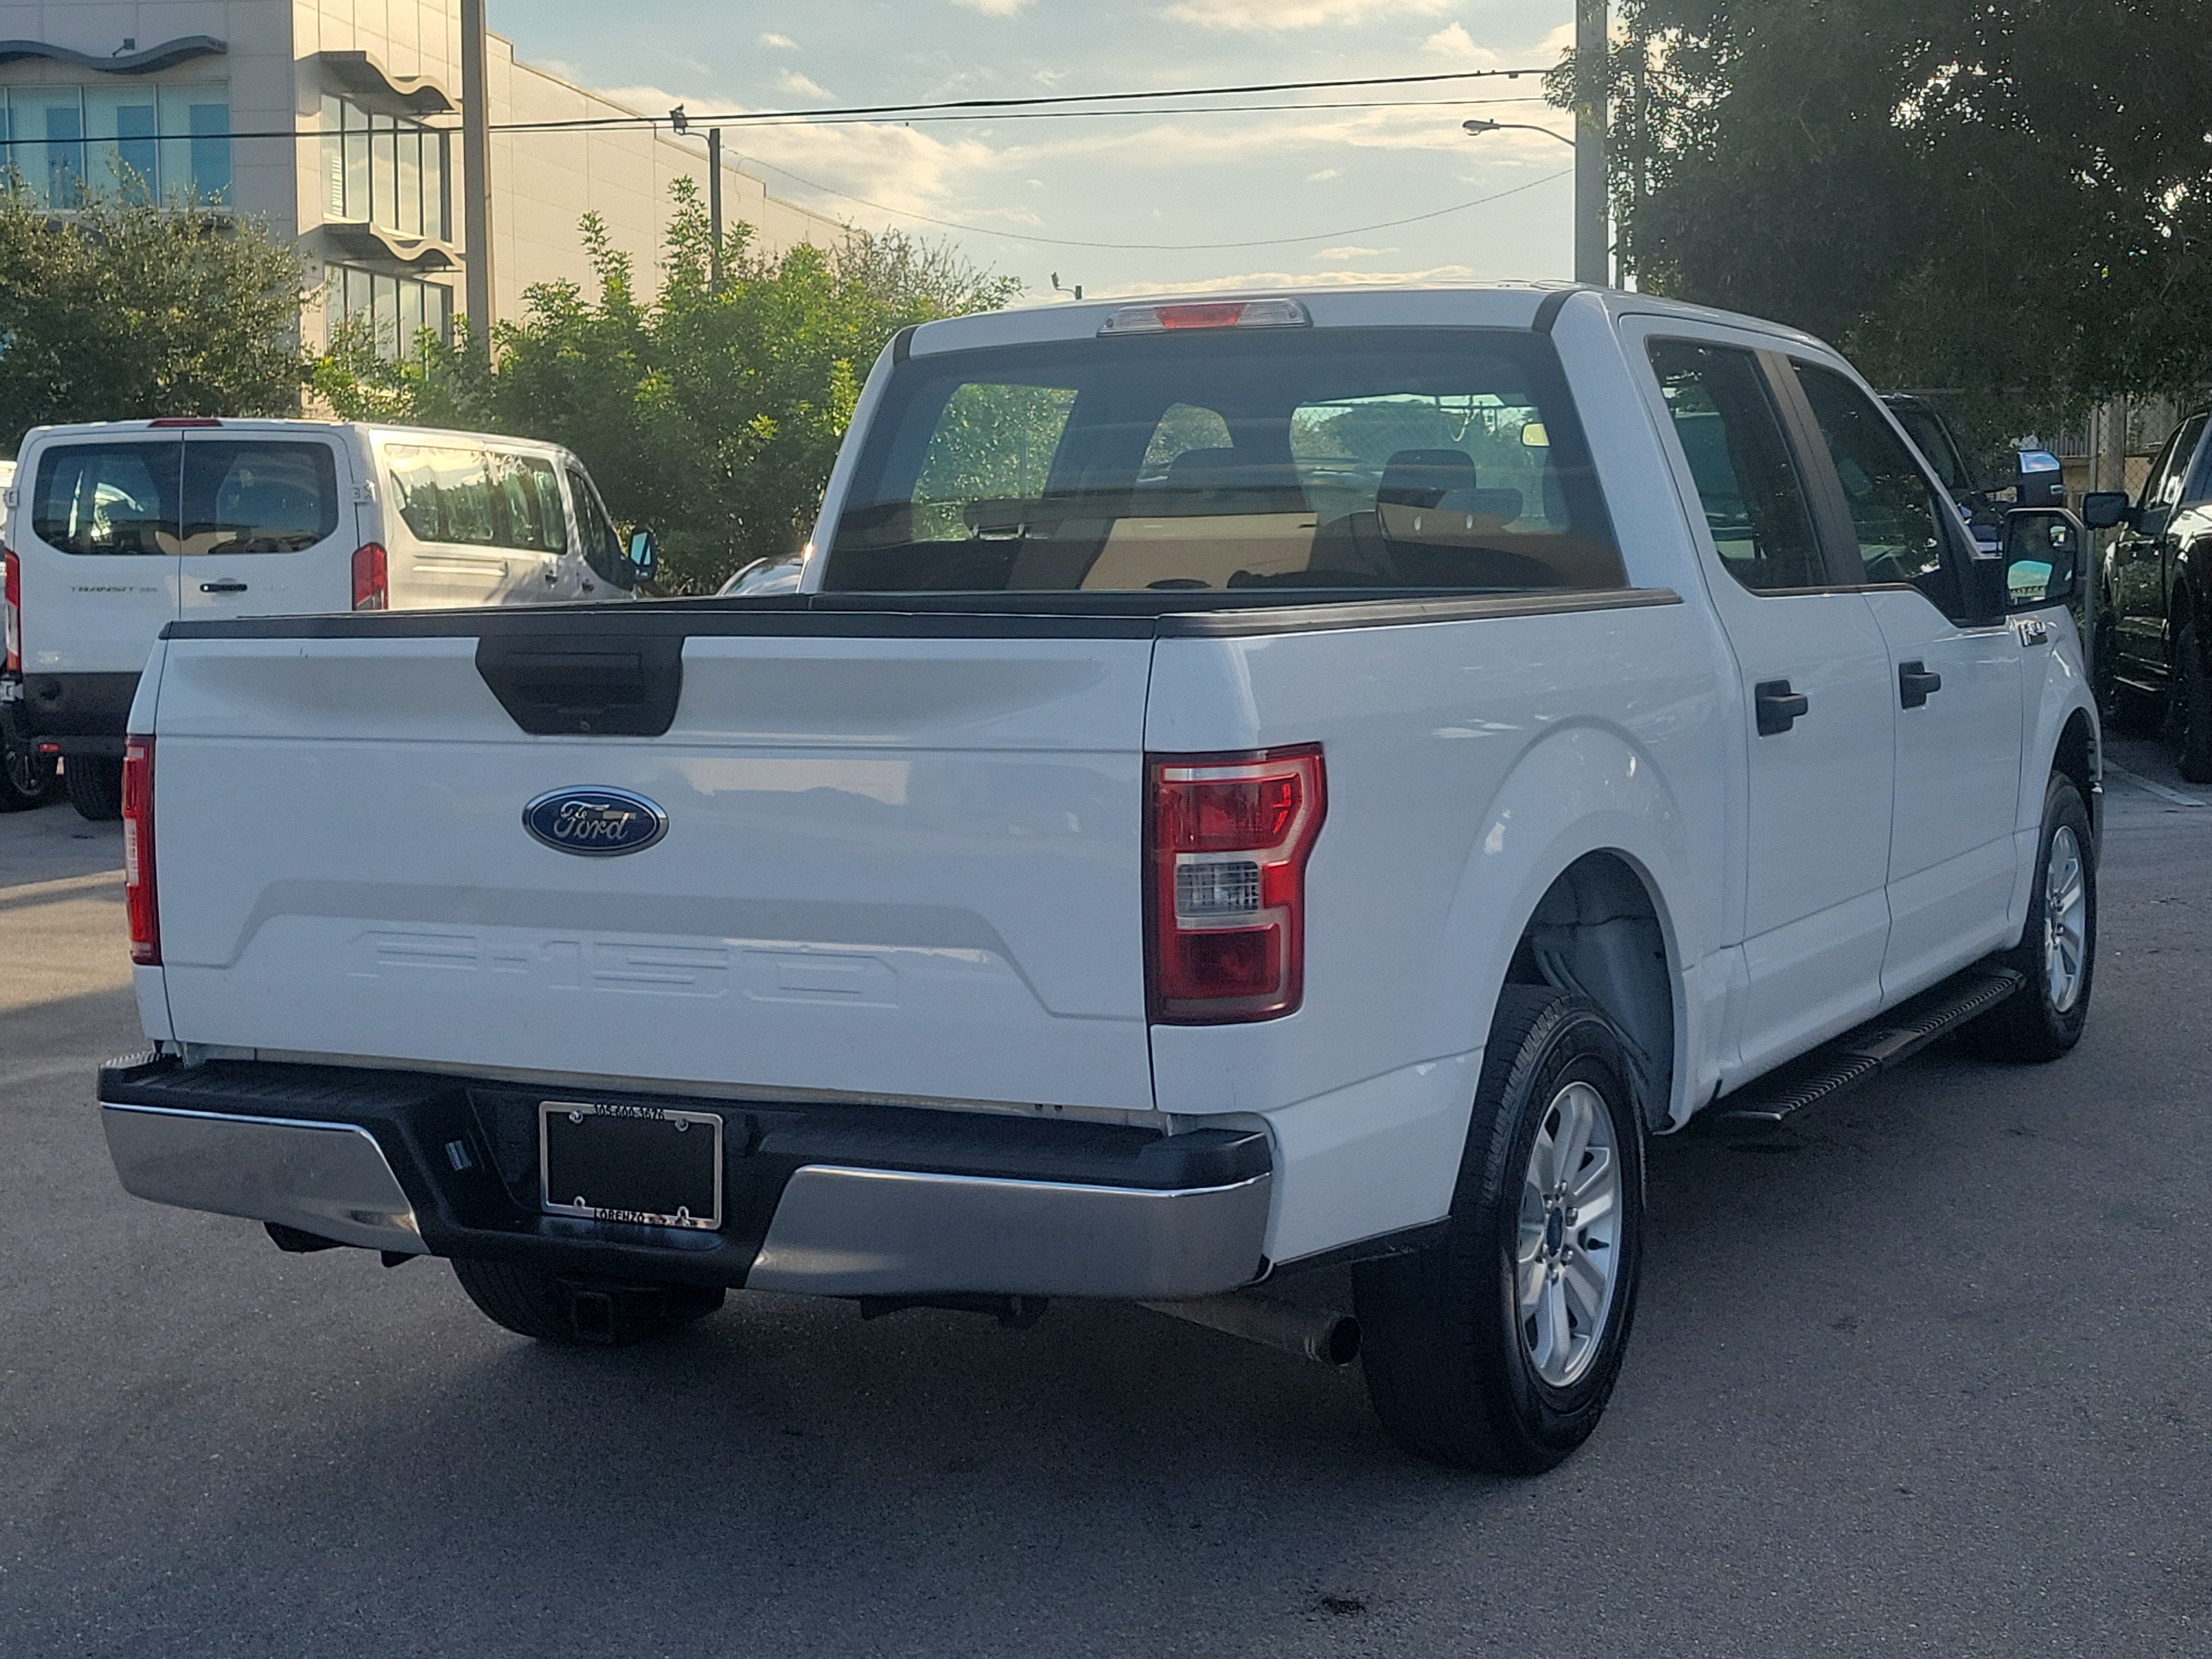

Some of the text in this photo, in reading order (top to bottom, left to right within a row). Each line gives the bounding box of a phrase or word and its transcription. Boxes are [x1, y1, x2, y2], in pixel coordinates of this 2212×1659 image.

[553, 800, 629, 840] Ford
[346, 928, 899, 1008] F-150
[594, 1208, 645, 1223] LORENZO
